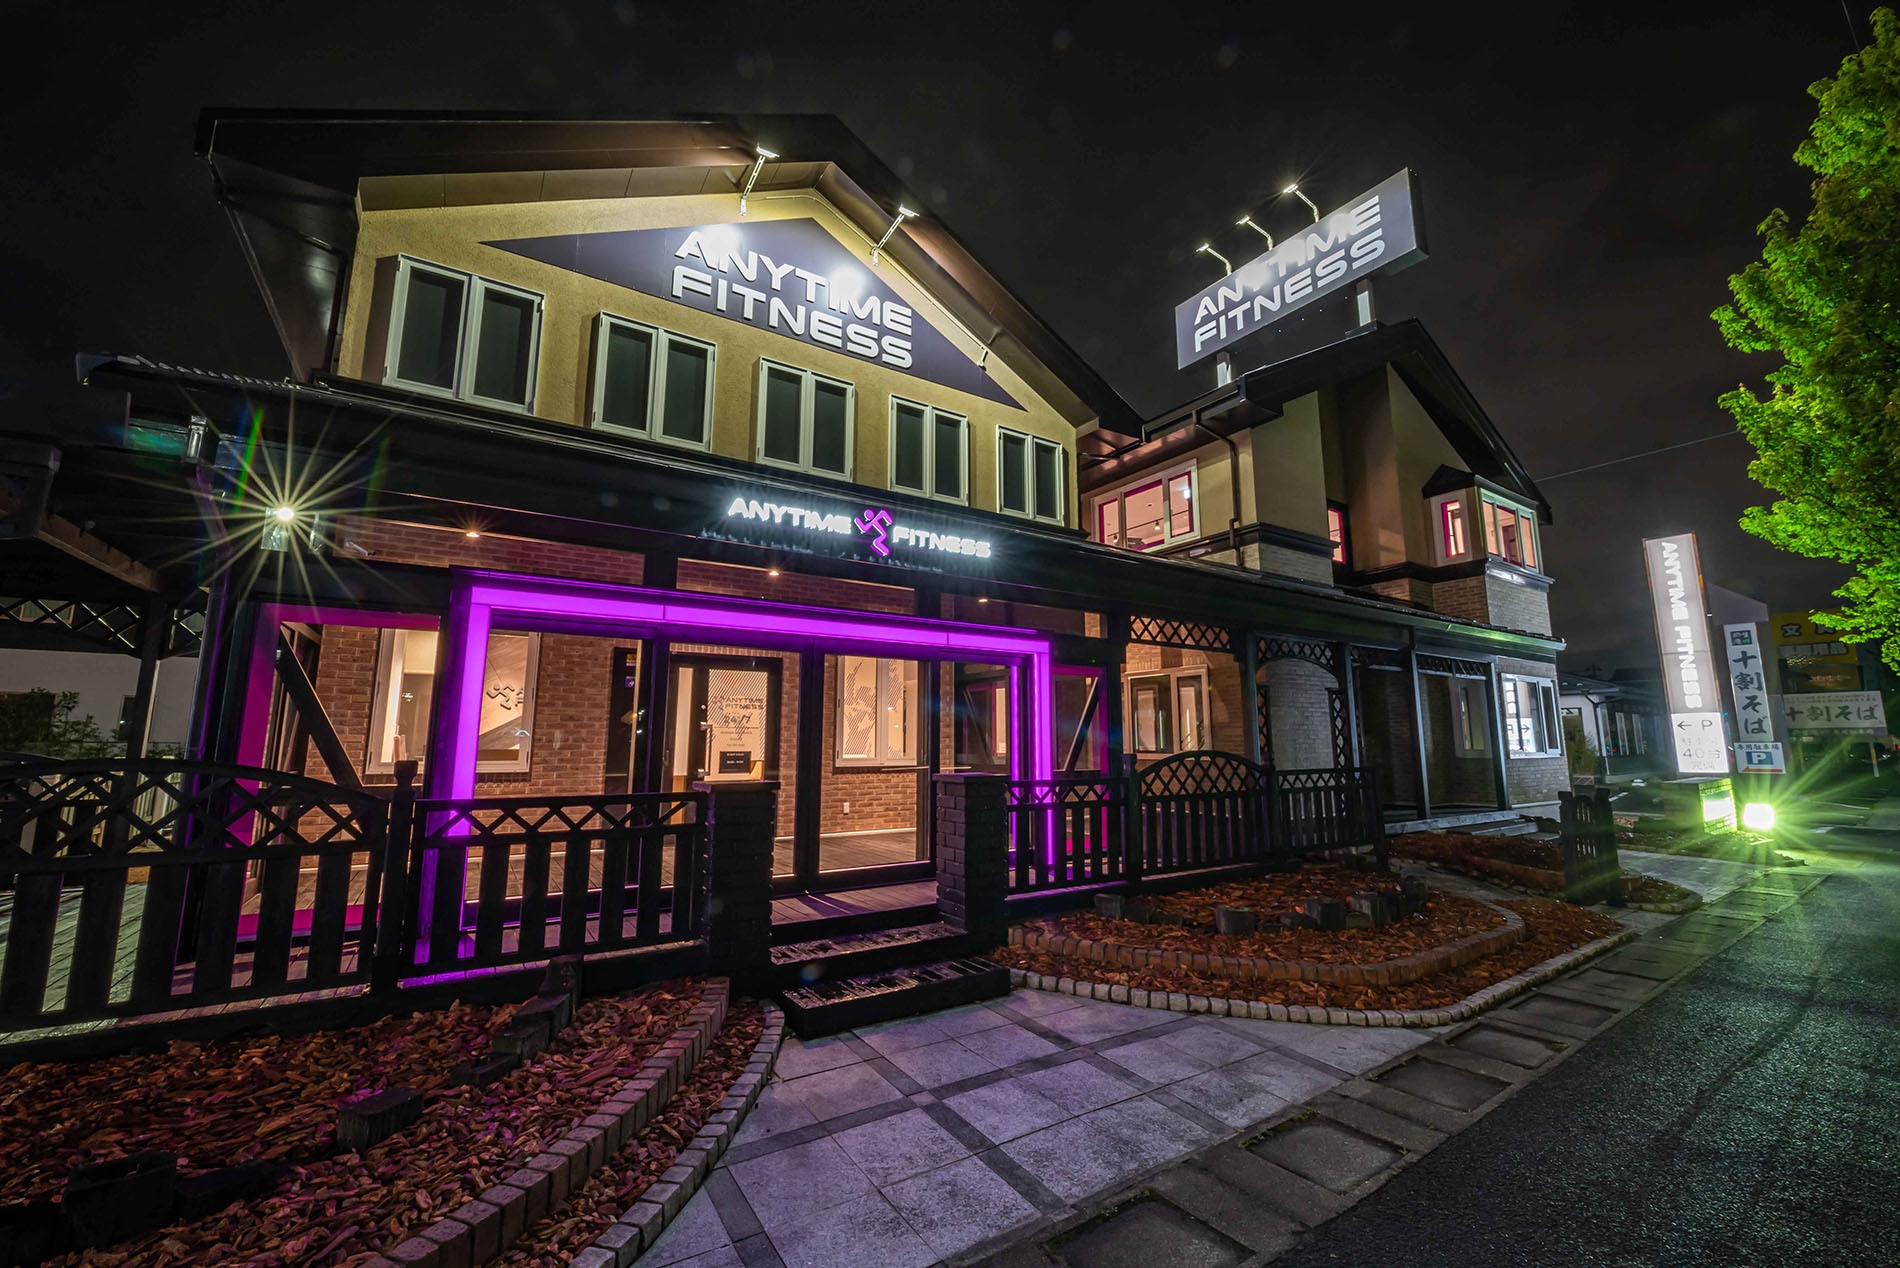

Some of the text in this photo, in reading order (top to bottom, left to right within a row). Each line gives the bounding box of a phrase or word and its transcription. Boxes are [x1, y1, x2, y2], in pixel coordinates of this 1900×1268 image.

[672, 265, 912, 369] FITNESS
[674, 229, 912, 336] ANYTIME
[1194, 228, 1385, 352] FITNESS
[728, 498, 991, 558] ANYTIME FITNESS
[1661, 541, 1689, 620] ANYTIME
[1674, 625, 1702, 708] FITNESS
[1732, 650, 1768, 735] 十割そば
[1701, 719, 1713, 731] P
[1786, 705, 1879, 722] 十割そば
[1752, 752, 1767, 764] P
